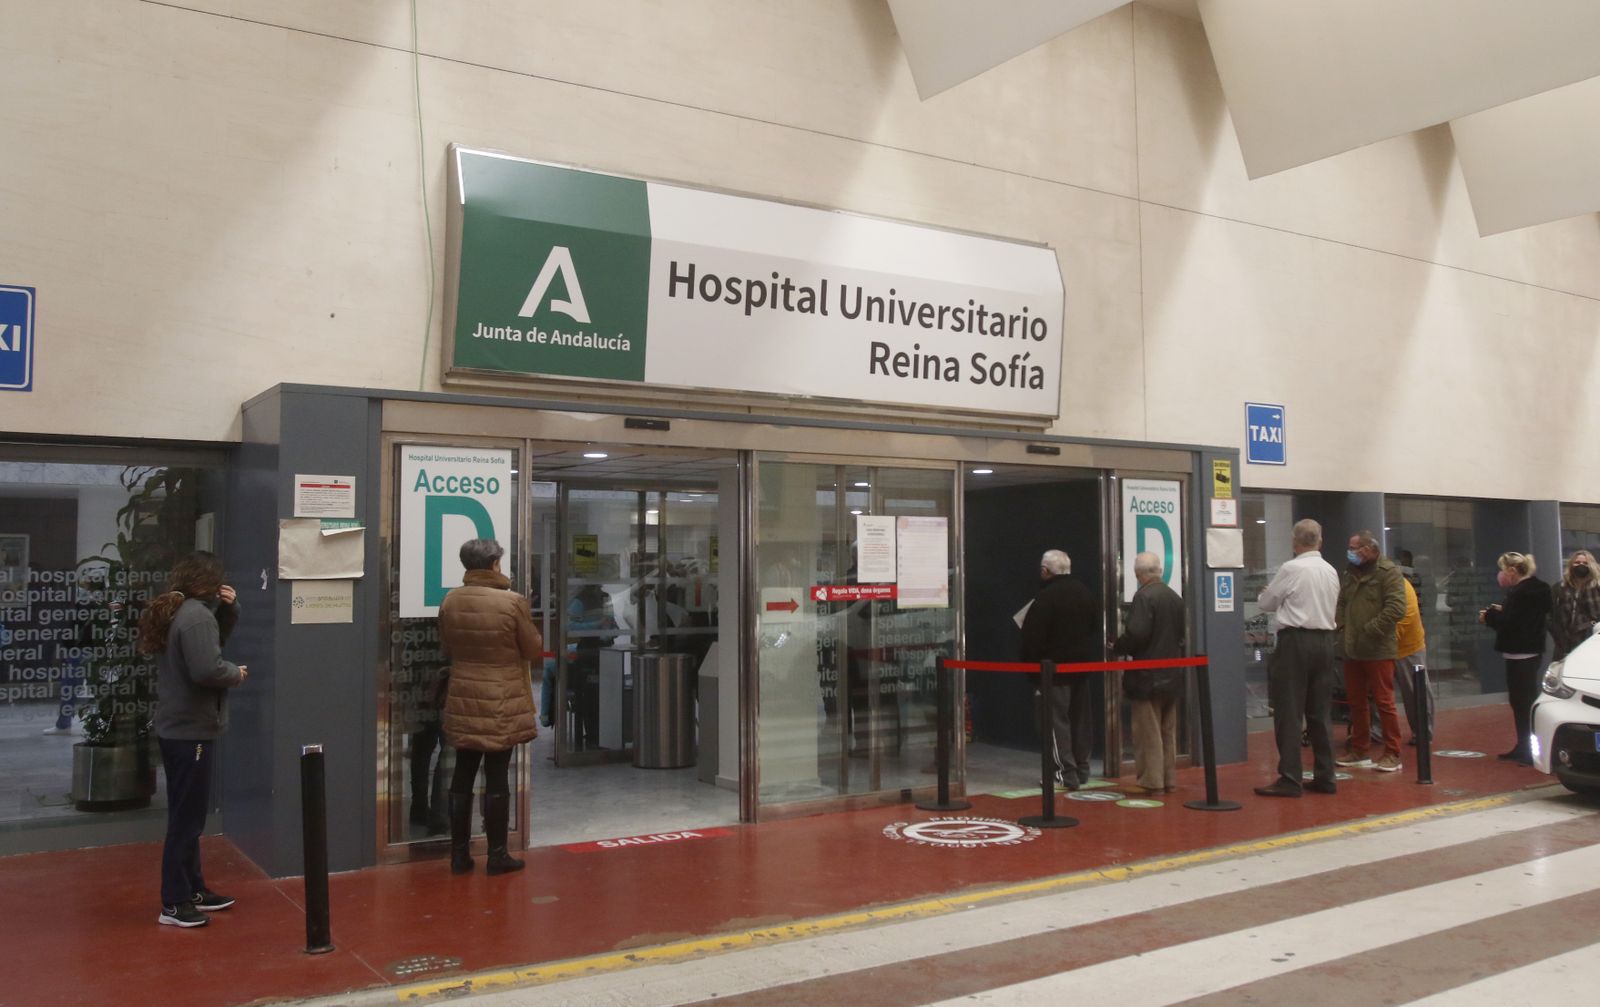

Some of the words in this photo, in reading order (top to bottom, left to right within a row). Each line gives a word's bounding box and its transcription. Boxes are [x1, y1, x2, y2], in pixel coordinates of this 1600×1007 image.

[668, 261, 828, 316] Hospital
[840, 284, 1048, 342] Universitario
[472, 322, 522, 342] Junta
[526, 327, 547, 344] de
[550, 329, 631, 351] Andalucía
[869, 341, 960, 383] Reina
[970, 351, 1044, 390] Sofía
[1250, 425, 1282, 443] TAXI
[408, 454, 434, 462] Hospital
[434, 455, 472, 463] Universitario
[413, 468, 500, 494] Acceso
[1130, 495, 1175, 514] Acceso
[115, 569, 170, 586] gener
[1, 586, 72, 607] ospital
[92, 624, 139, 642] hosp
[0, 644, 43, 661] eral
[9, 663, 92, 683] hospital
[0, 682, 54, 703] spital
[596, 831, 703, 848] SALIDA
